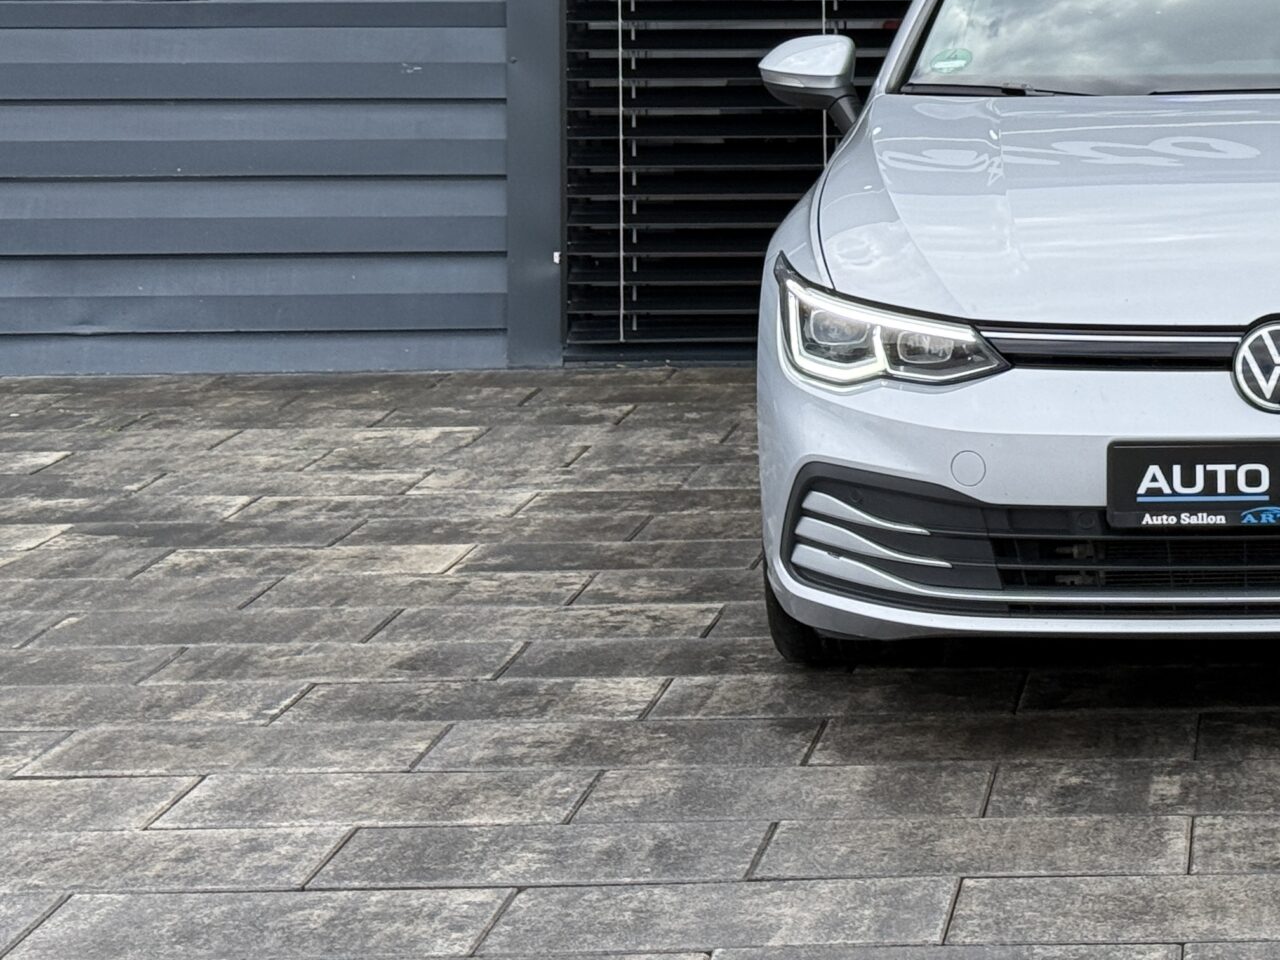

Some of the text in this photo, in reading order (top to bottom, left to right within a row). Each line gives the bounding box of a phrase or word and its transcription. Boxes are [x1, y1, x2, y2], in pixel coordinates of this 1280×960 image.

[1136, 463, 1271, 495] AUTO
[1141, 512, 1227, 525] Auto Sallon
